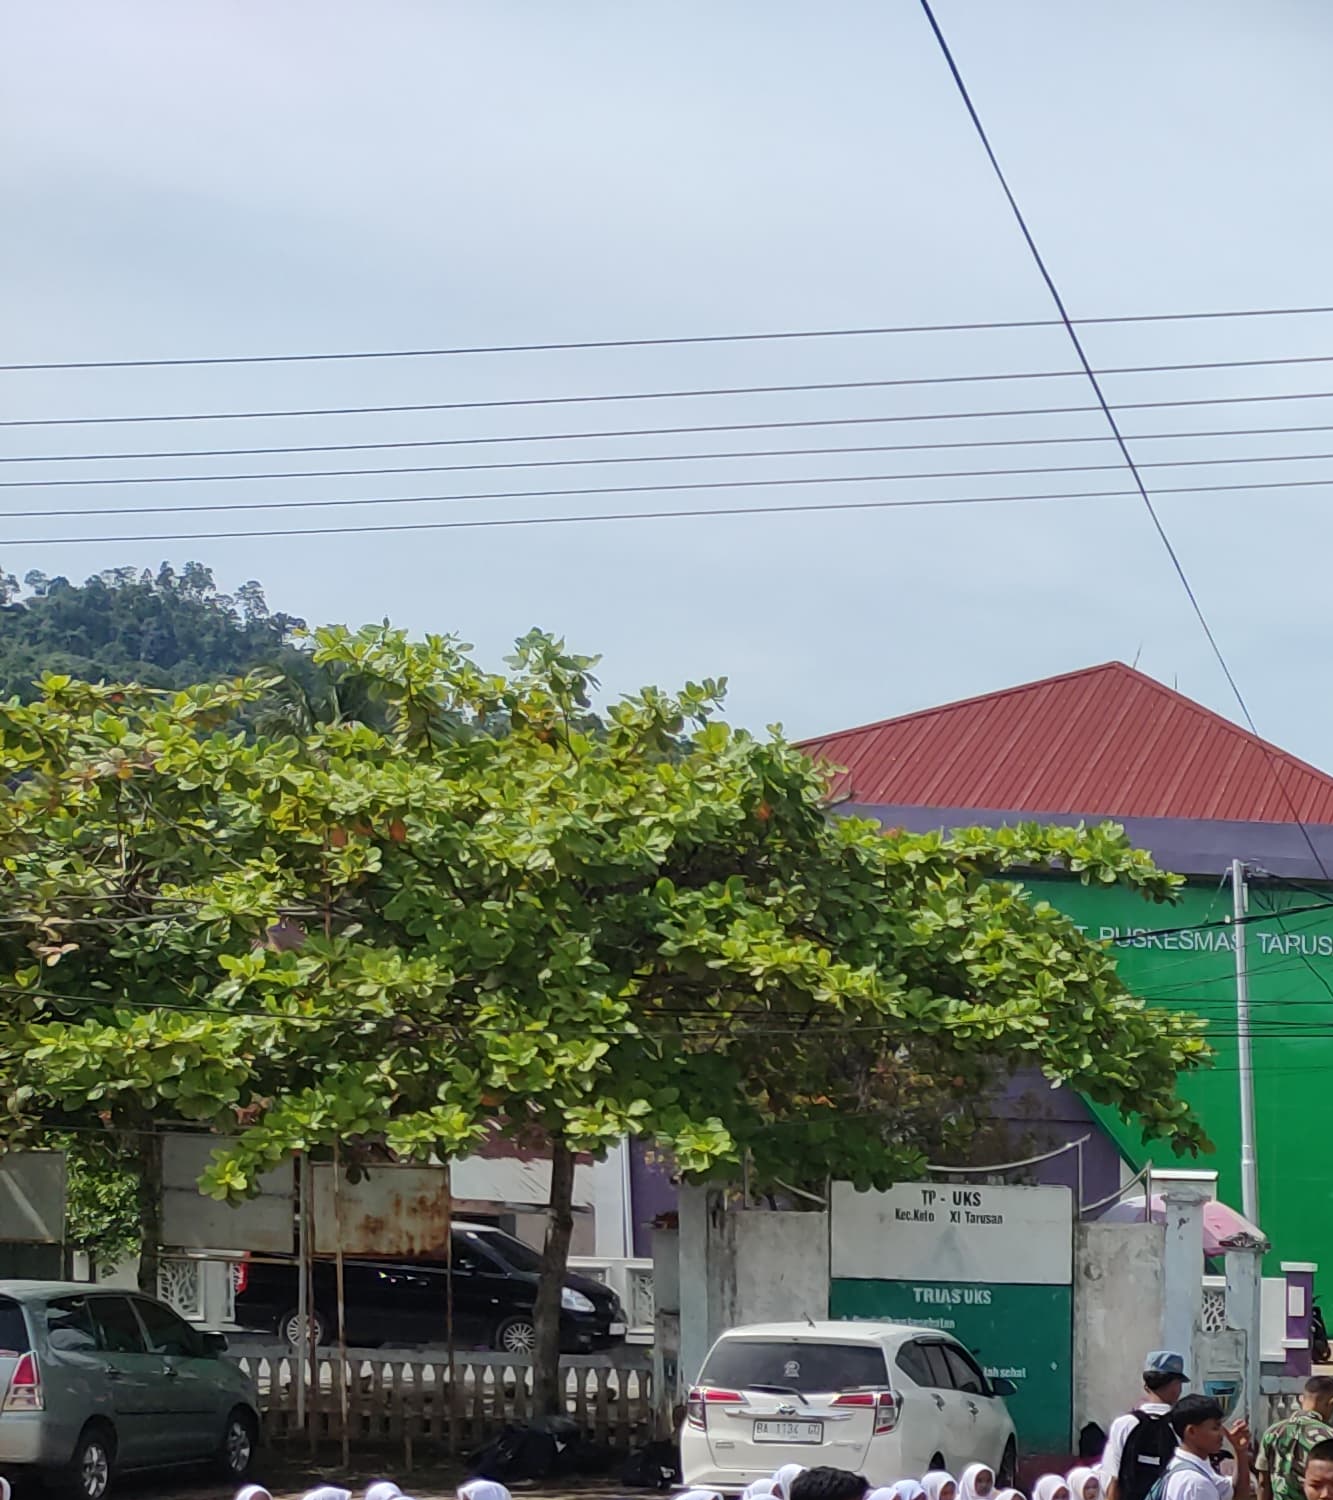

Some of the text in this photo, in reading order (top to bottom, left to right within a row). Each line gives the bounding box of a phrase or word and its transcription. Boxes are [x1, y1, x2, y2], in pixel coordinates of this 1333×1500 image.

[921, 1189, 936, 1206] TP
[952, 1190, 982, 1207] UKS
[965, 1211, 1004, 1225] Tarusan
[913, 1287, 992, 1305] TRIAS UKS
